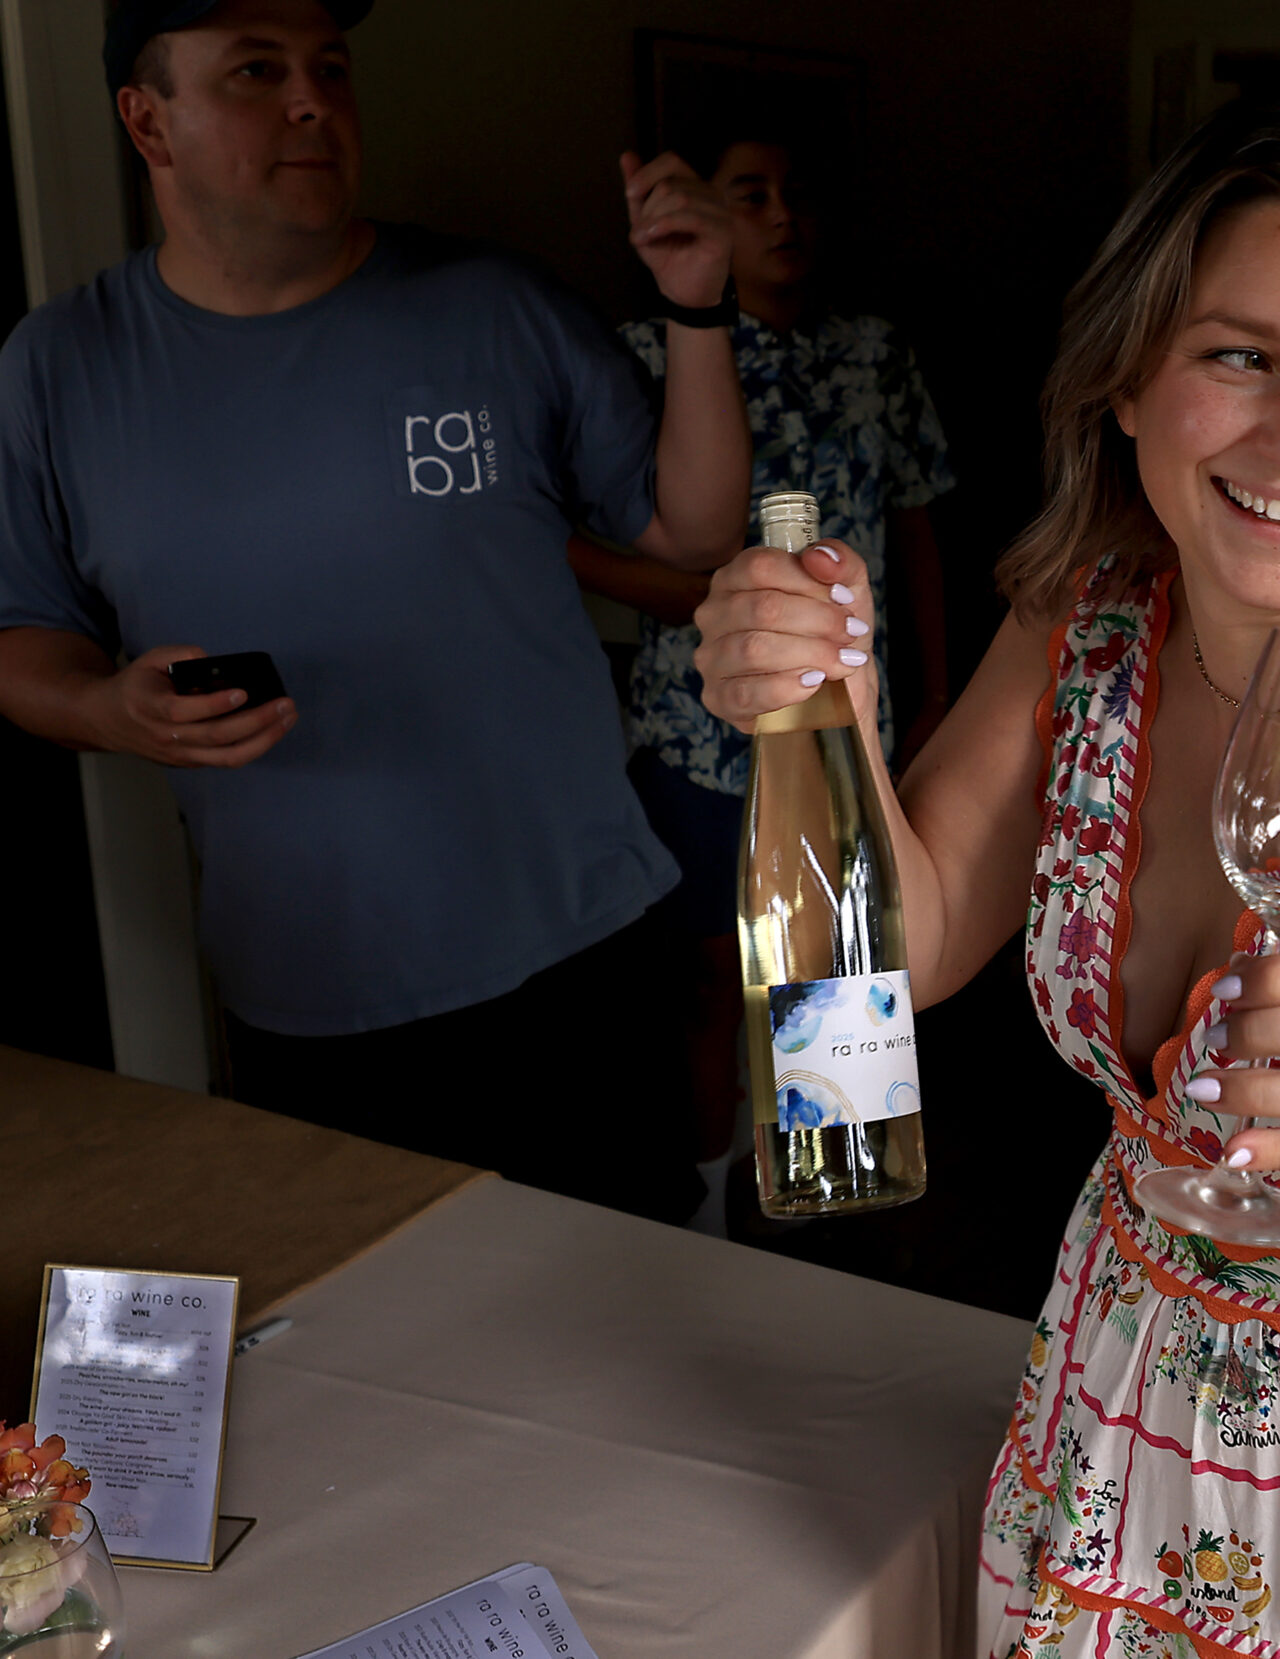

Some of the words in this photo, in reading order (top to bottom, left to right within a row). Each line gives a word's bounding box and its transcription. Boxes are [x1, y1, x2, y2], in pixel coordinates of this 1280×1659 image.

[482, 439, 498, 485] wine
[832, 1044, 851, 1057] ra
[860, 1041, 877, 1053] ra
[884, 1034, 911, 1050] wine
[105, 1289, 123, 1301] ra
[131, 1289, 174, 1305] wine
[181, 1296, 207, 1310] co.
[498, 1627, 524, 1659] wine
[545, 1619, 568, 1654] wine
